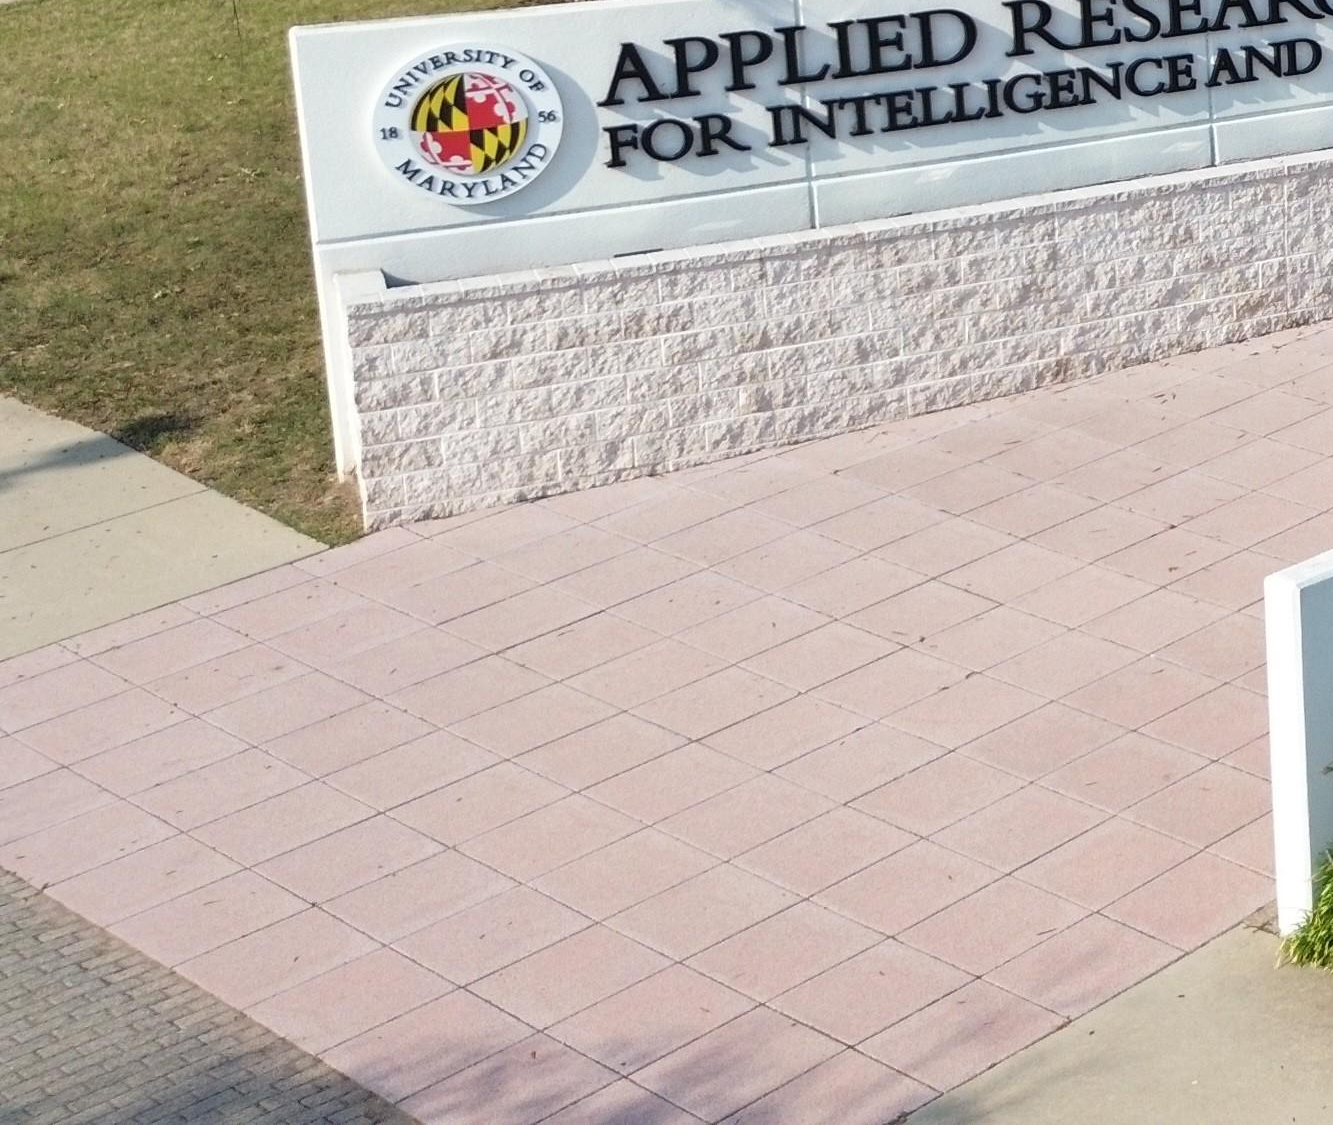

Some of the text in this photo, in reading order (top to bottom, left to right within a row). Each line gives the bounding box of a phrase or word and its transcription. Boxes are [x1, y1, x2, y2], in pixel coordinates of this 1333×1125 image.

[384, 49, 546, 109] UNIVERSITY OF
[597, 8, 978, 107] APPLIED
[537, 110, 558, 124] 56
[602, 111, 752, 169] FOR
[765, 53, 1198, 148] INTELLIGENCE
[1204, 37, 1323, 89] AND
[380, 126, 399, 141] 18
[395, 143, 548, 199] MARYLAND
